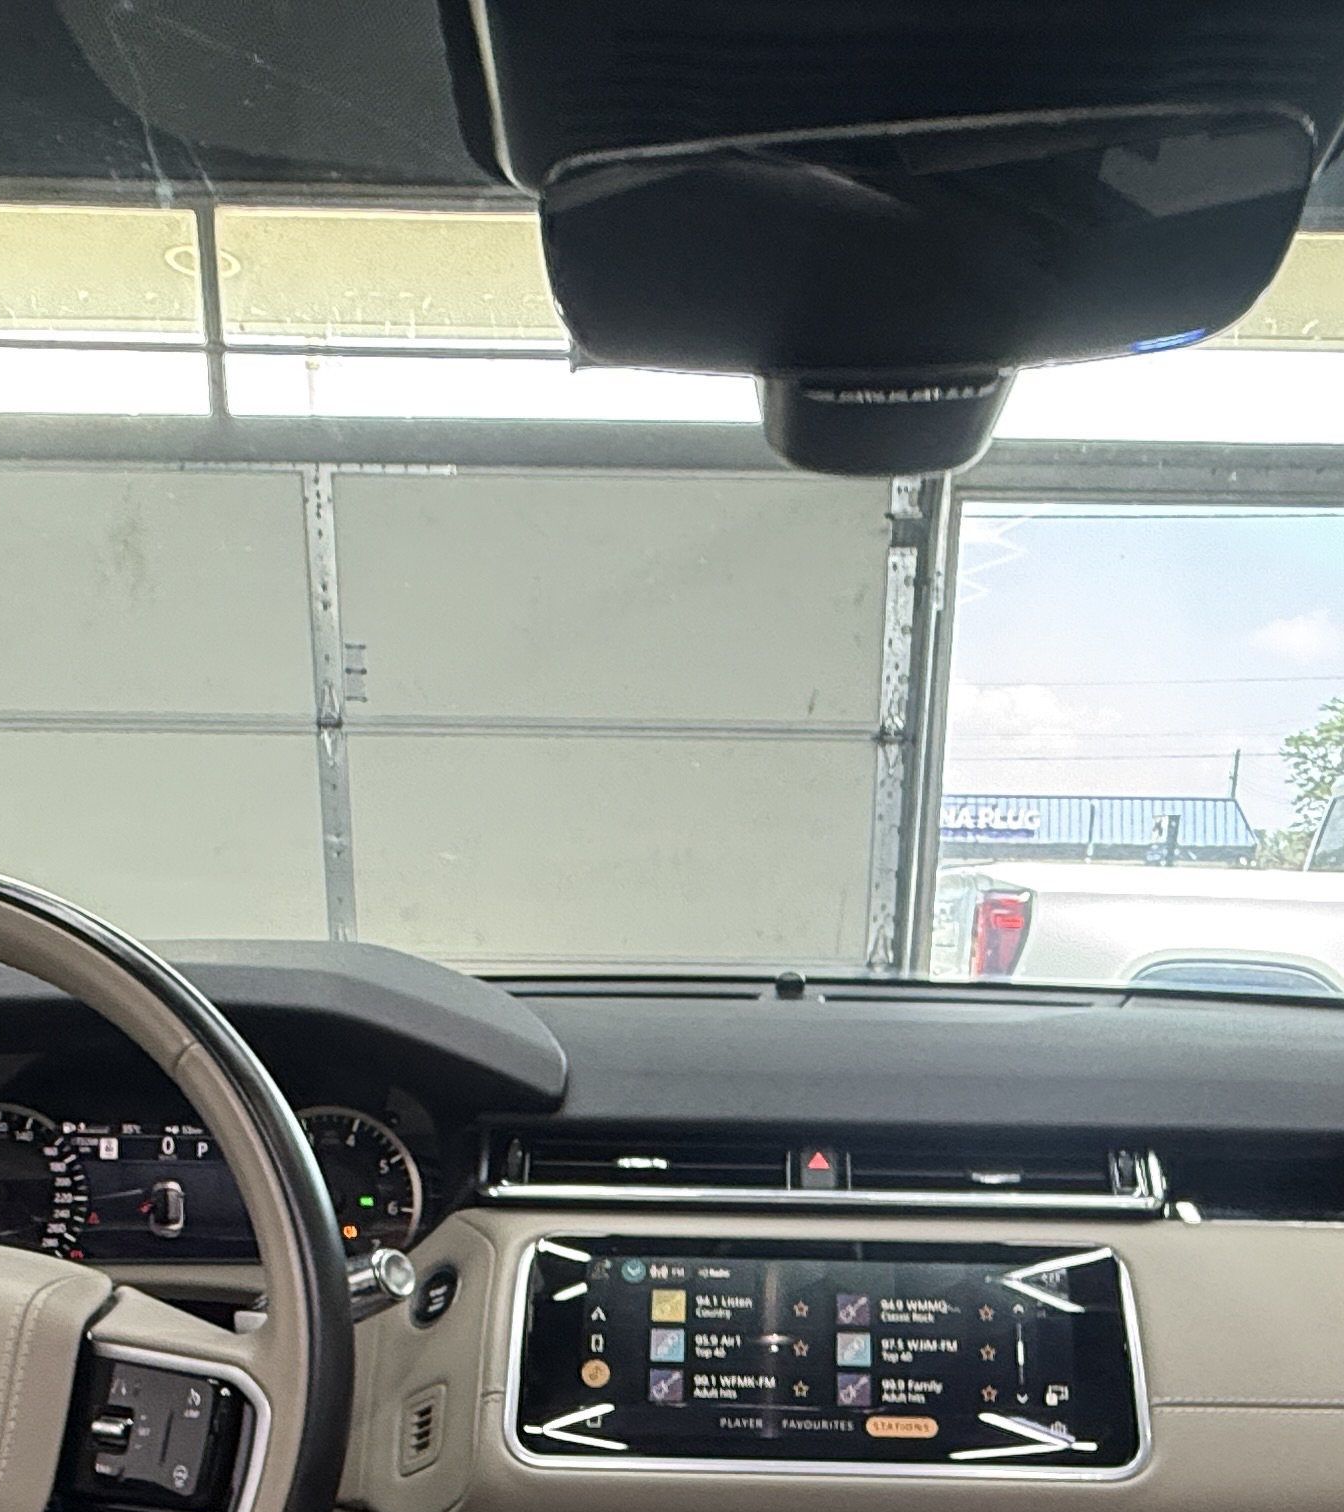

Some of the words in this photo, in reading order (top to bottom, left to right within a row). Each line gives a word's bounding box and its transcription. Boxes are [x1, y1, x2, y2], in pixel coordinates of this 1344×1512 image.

[977, 807, 1040, 830] PLUG
[162, 1136, 174, 1155] 0
[346, 1134, 355, 1147] 4
[197, 1141, 208, 1158] P
[379, 1159, 389, 1174] 5
[387, 1201, 398, 1215] 6
[695, 1346, 712, 1359] Top
[882, 1351, 899, 1364] Top
[908, 1379, 943, 1395] Family
[720, 1417, 763, 1429] PLAYER
[781, 1419, 855, 1432] FAVOURITES
[874, 1421, 930, 1432] STATIONS
